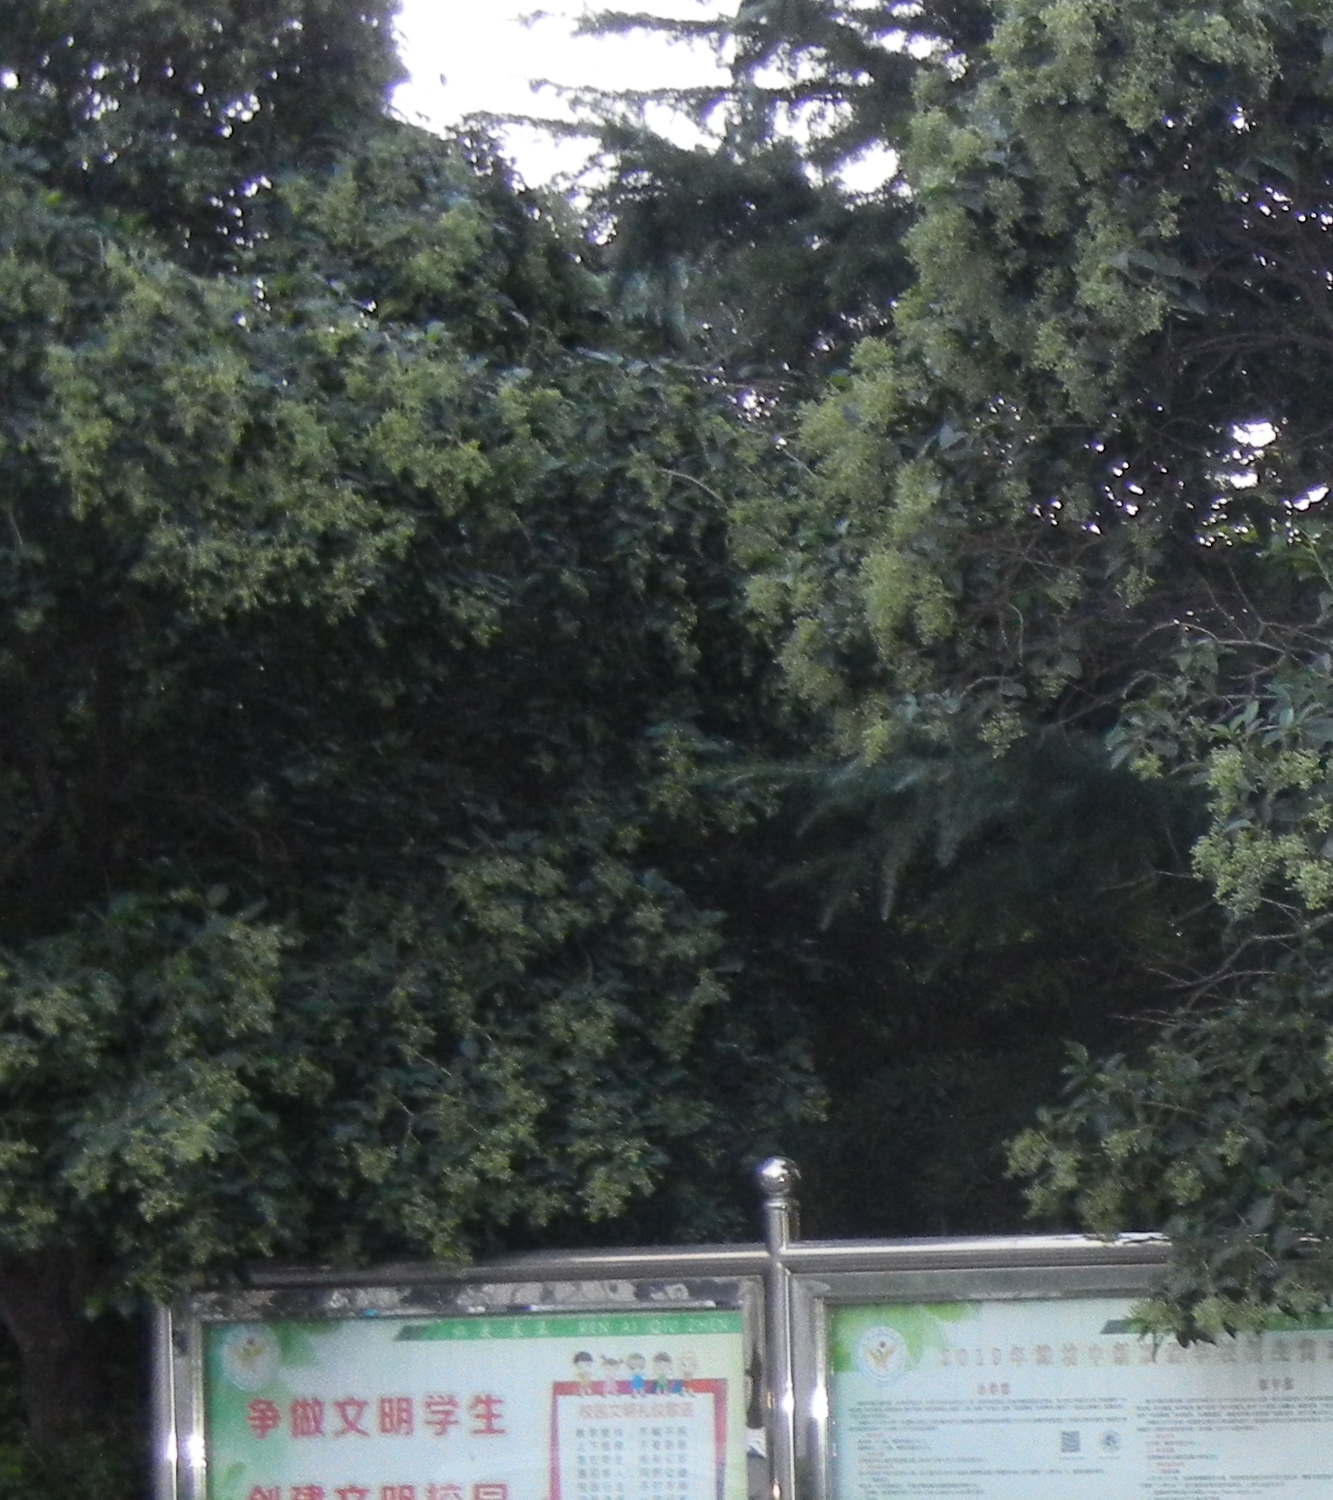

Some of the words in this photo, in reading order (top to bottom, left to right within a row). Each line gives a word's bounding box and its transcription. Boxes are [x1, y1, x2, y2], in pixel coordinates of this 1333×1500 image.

[246, 1394, 506, 1440] 争做文明学生
